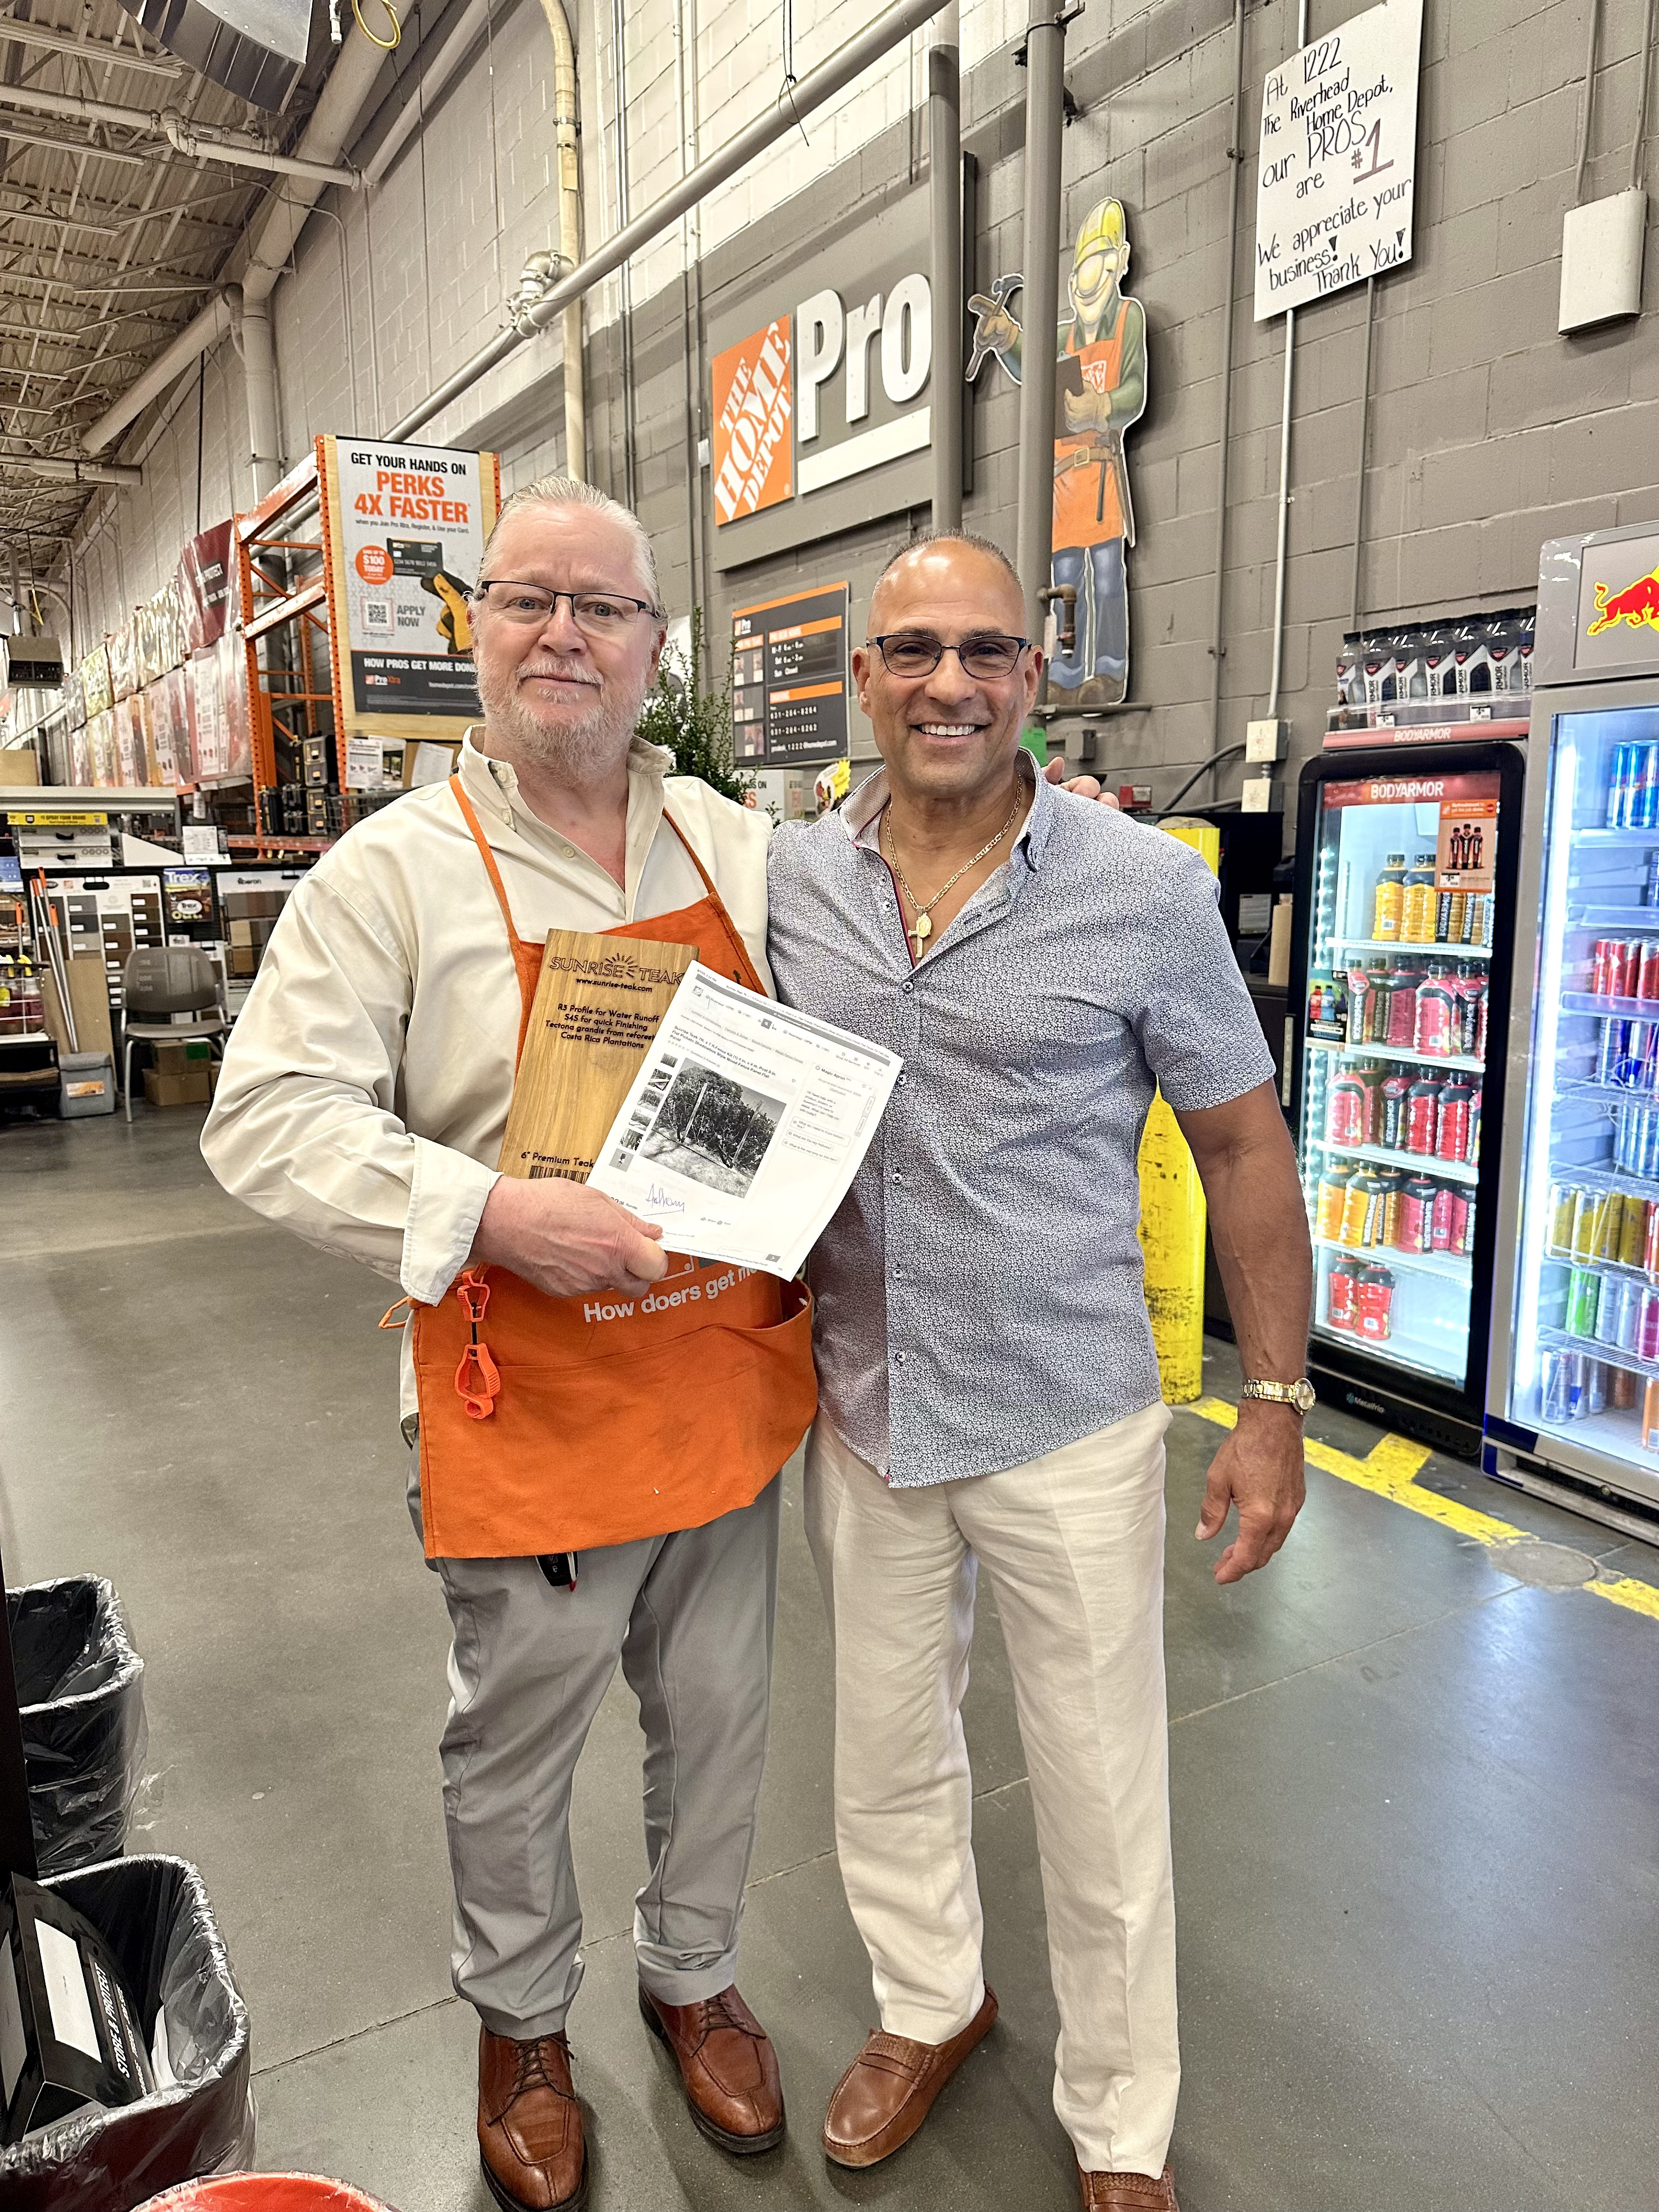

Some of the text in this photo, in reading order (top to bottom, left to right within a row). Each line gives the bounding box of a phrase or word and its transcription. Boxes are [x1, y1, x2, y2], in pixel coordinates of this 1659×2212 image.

[1268, 37, 1341, 105] At 1222
[1263, 67, 1350, 136] The Riverhead
[1307, 75, 1392, 135] Home Depot,
[1262, 111, 1366, 187] our PROS
[1297, 119, 1394, 198] are #1
[1259, 179, 1411, 266] We appreciate your
[1269, 235, 1338, 290] business!
[1312, 228, 1406, 292] Thank You!
[797, 273, 932, 442] Pro
[720, 357, 751, 435] THE
[714, 322, 790, 521] HOME
[743, 385, 791, 512] DEPOT
[352, 453, 466, 475] GET YOUR HANDS ON
[377, 471, 445, 498] PERKS
[354, 493, 383, 516] 4X
[363, 554, 385, 565] $100
[397, 605, 426, 616] APPLY
[398, 617, 419, 627] NOW
[364, 658, 385, 668] HOW
[386, 659, 409, 669] PROS
[411, 660, 427, 670] GET
[429, 662, 454, 672] MORE
[1394, 727, 1452, 741] BODYARMOR
[1371, 781, 1444, 799] BODYARMOR
[164, 871, 203, 884] Trex
[550, 956, 624, 978] SUNRISE
[640, 968, 685, 985] TEAK
[576, 978, 652, 992] www.sunrise-teak.com
[558, 1003, 659, 1023] R3 Profile for Water Runoff
[581, 1015, 591, 1024] for
[594, 1017, 613, 1026] quick
[616, 1019, 648, 1031] Finishing
[546, 1020, 574, 1030] Tectona
[576, 1024, 604, 1034] grandis
[606, 1027, 624, 1037] from
[561, 1031, 645, 1048] Costa Rica Plantations
[821, 1068, 845, 1081] Magic Apron
[532, 1152, 570, 1165] Premium
[574, 1157, 595, 1168] Teak
[584, 1301, 634, 1323] How
[641, 1285, 701, 1313] doers
[706, 1269, 735, 1300] get
[94, 1962, 130, 2078] STORE & PROTECT
